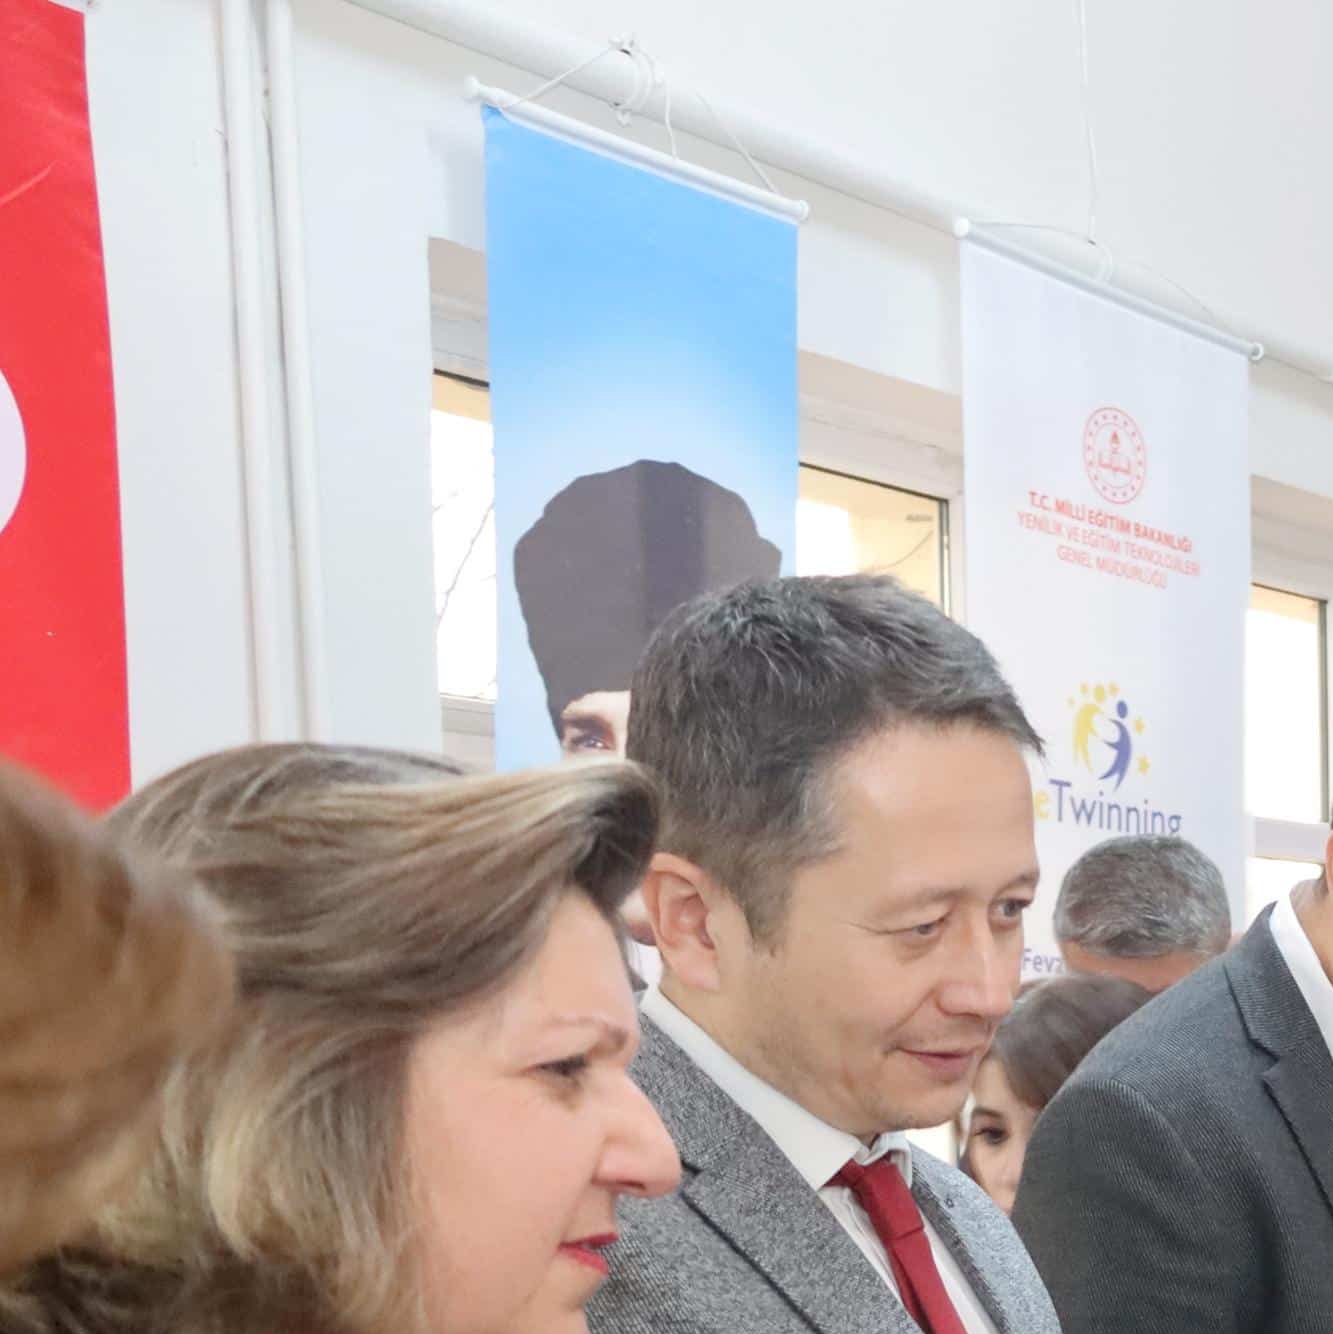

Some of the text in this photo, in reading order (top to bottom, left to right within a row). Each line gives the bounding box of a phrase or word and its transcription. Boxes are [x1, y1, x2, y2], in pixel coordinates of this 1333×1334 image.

[1028, 490, 1051, 511] T.C.
[1055, 497, 1086, 521] MİLLİ
[1088, 507, 1131, 535] EĞİTİM
[1034, 778, 1182, 834] eTwinning
